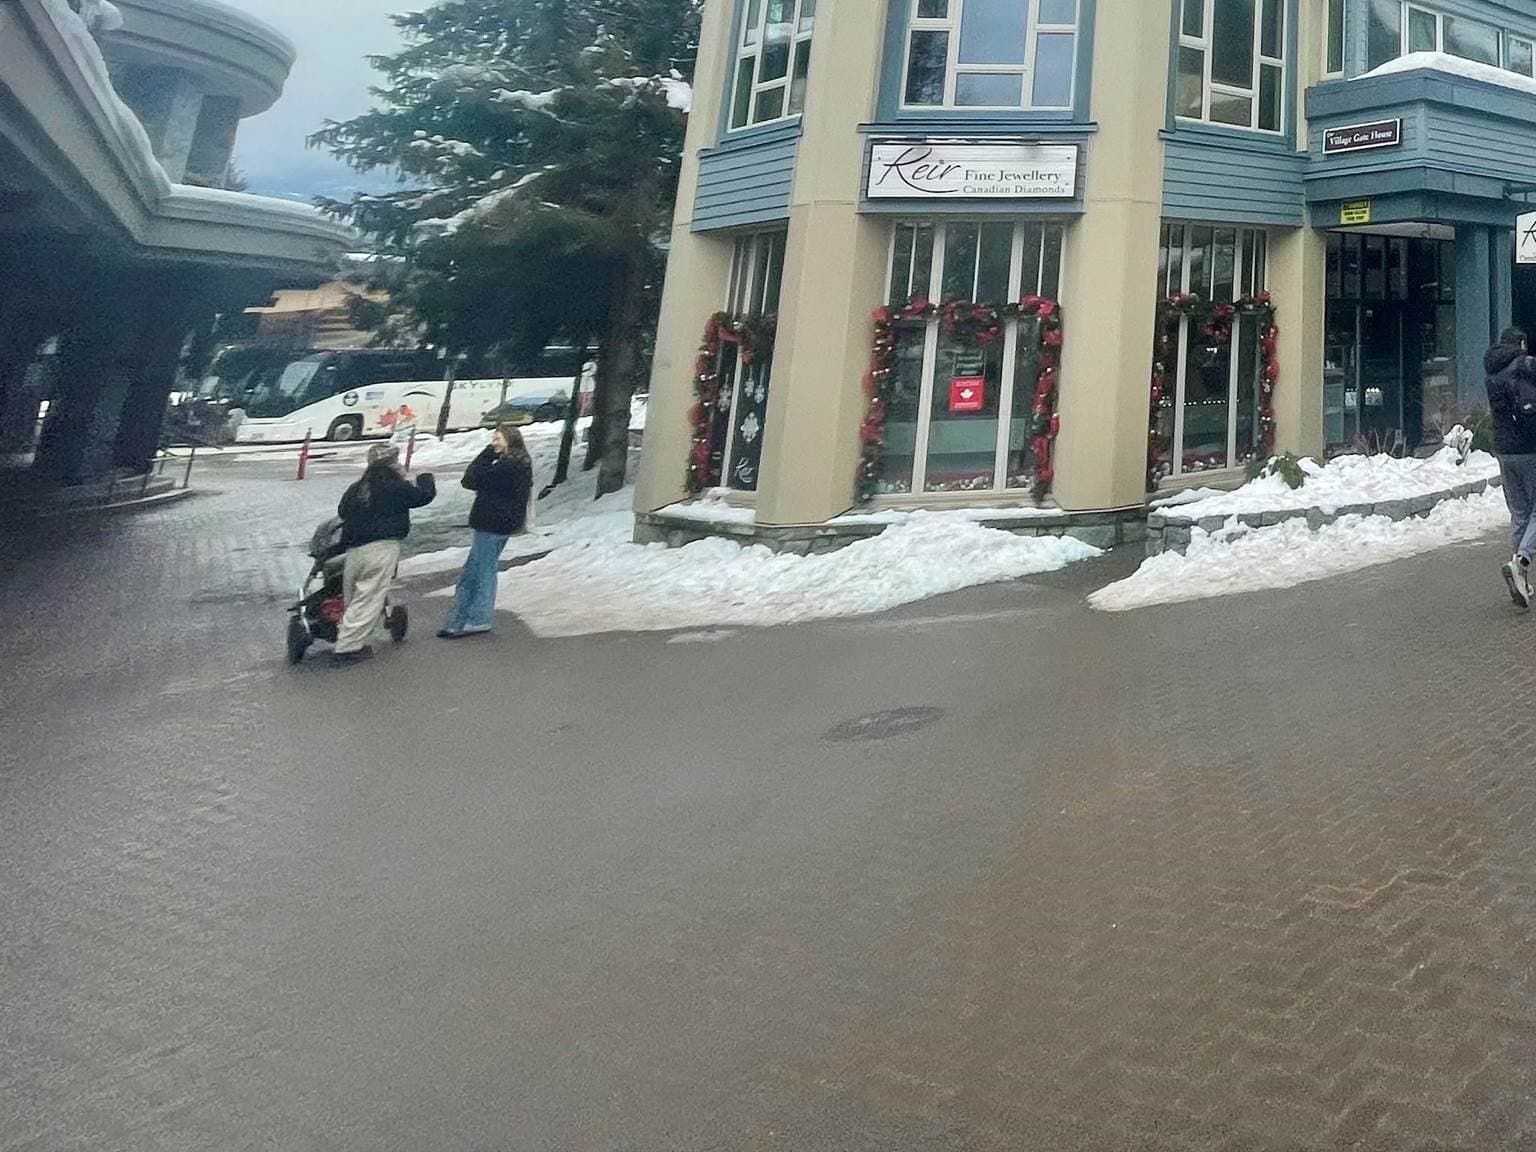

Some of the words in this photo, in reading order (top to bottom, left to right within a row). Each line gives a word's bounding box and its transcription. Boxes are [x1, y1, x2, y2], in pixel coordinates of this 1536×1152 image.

[1329, 135, 1352, 146] Village
[1353, 133, 1369, 142] Gate
[1370, 130, 1393, 140] House
[965, 169, 996, 181] Fine
[998, 169, 1061, 183] Jewellery
[963, 185, 1011, 194] Canadian
[1014, 184, 1066, 194] Diamonds
